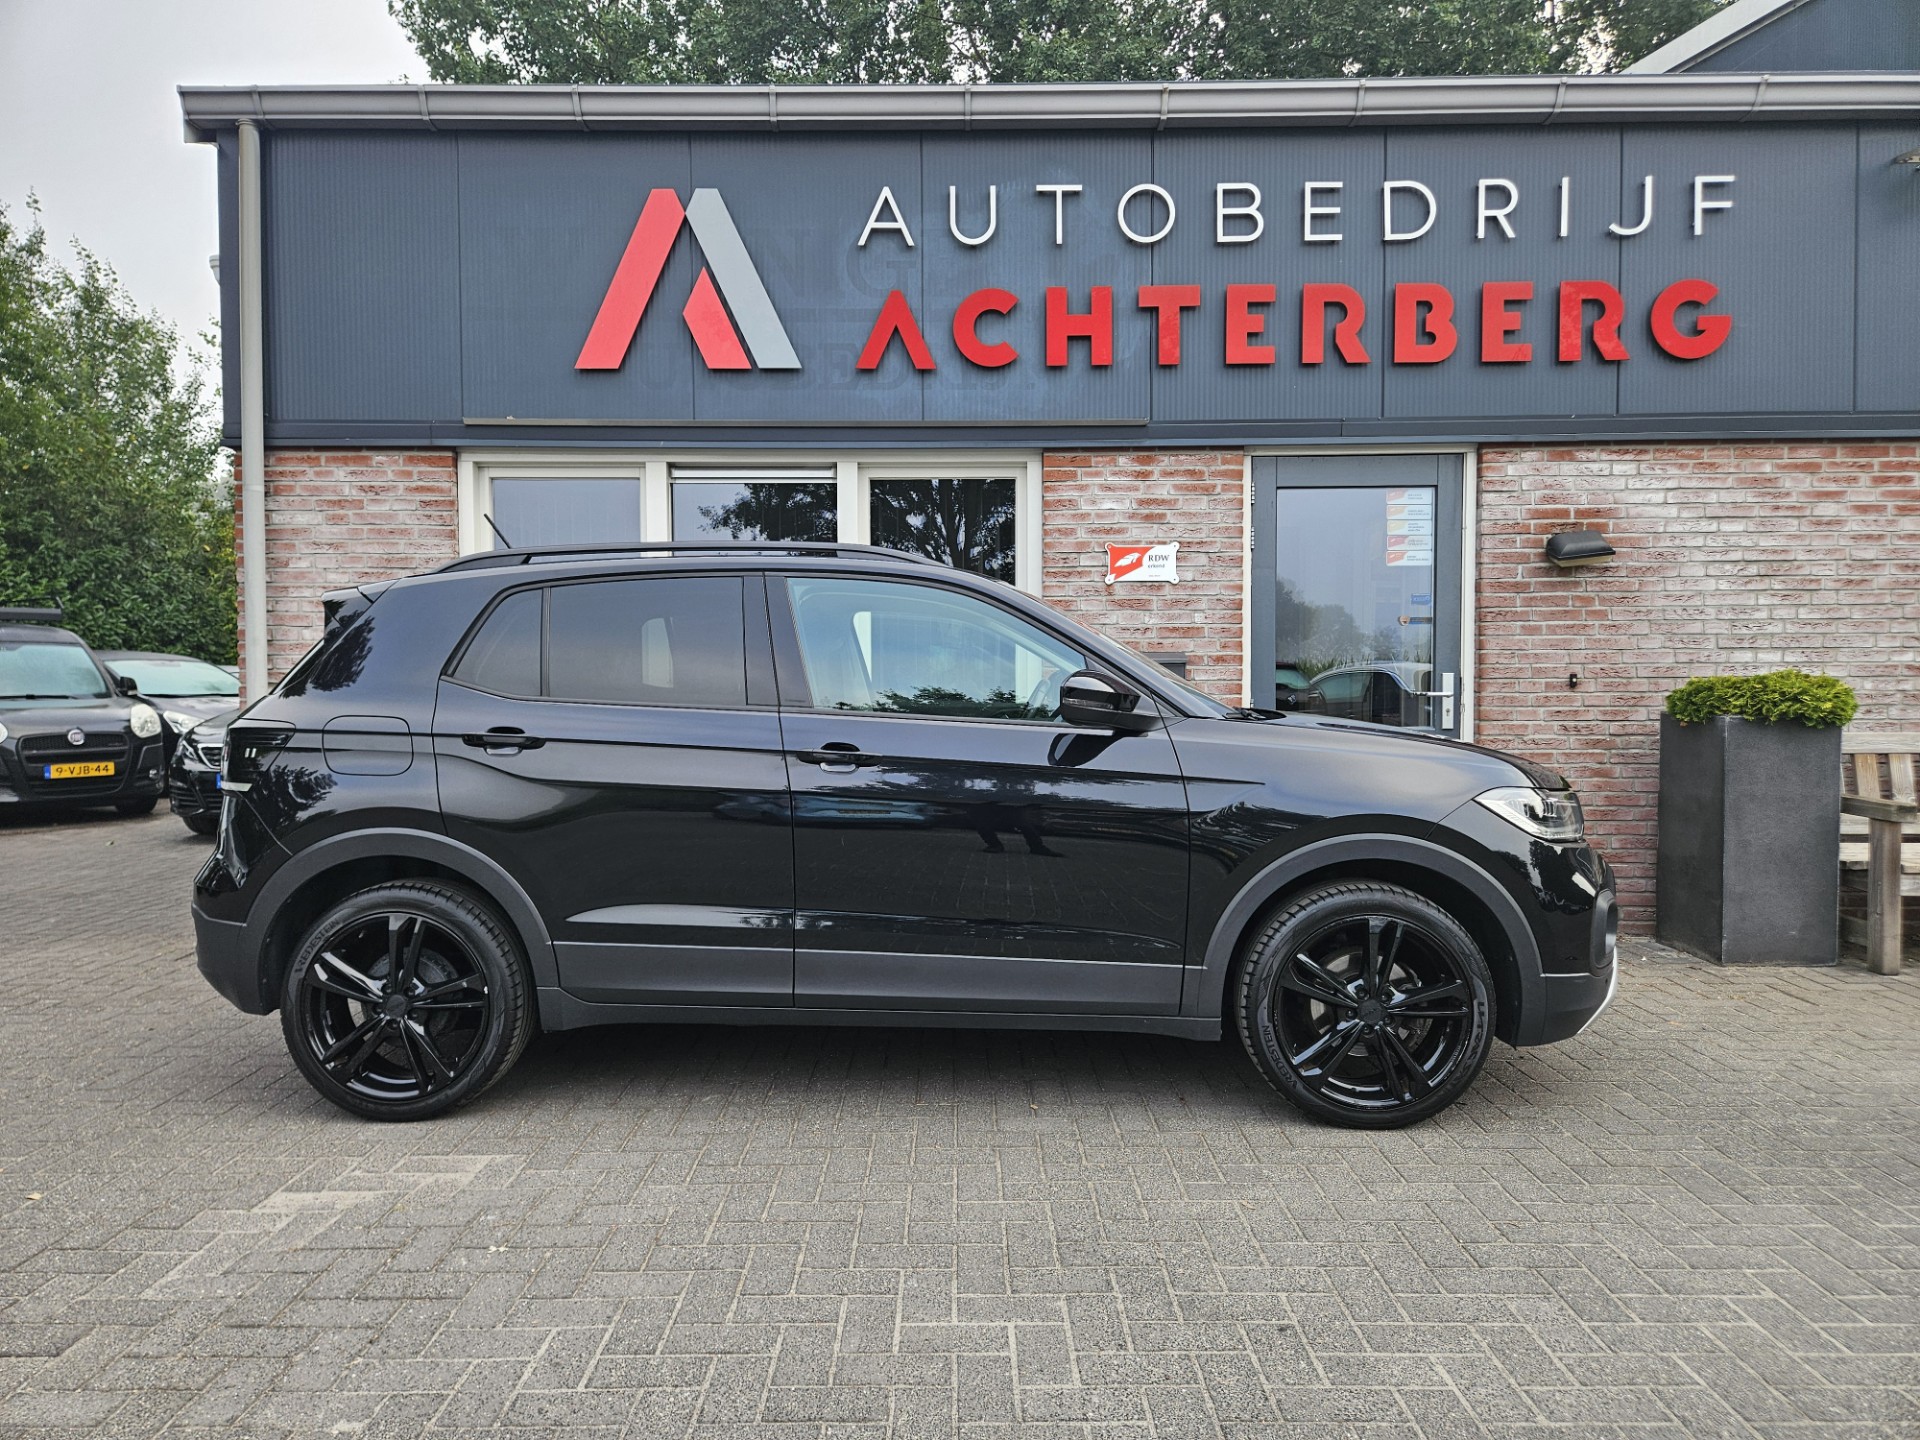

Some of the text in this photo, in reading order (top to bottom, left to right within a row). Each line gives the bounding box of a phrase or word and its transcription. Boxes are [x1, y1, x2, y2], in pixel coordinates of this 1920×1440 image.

[857, 175, 1735, 246] AUTOBEDRIJF
[855, 279, 1733, 369] ACHTERBERG
[294, 918, 340, 973] VREDESTEIN
[1261, 1025, 1297, 1089] VREDESTEIN
